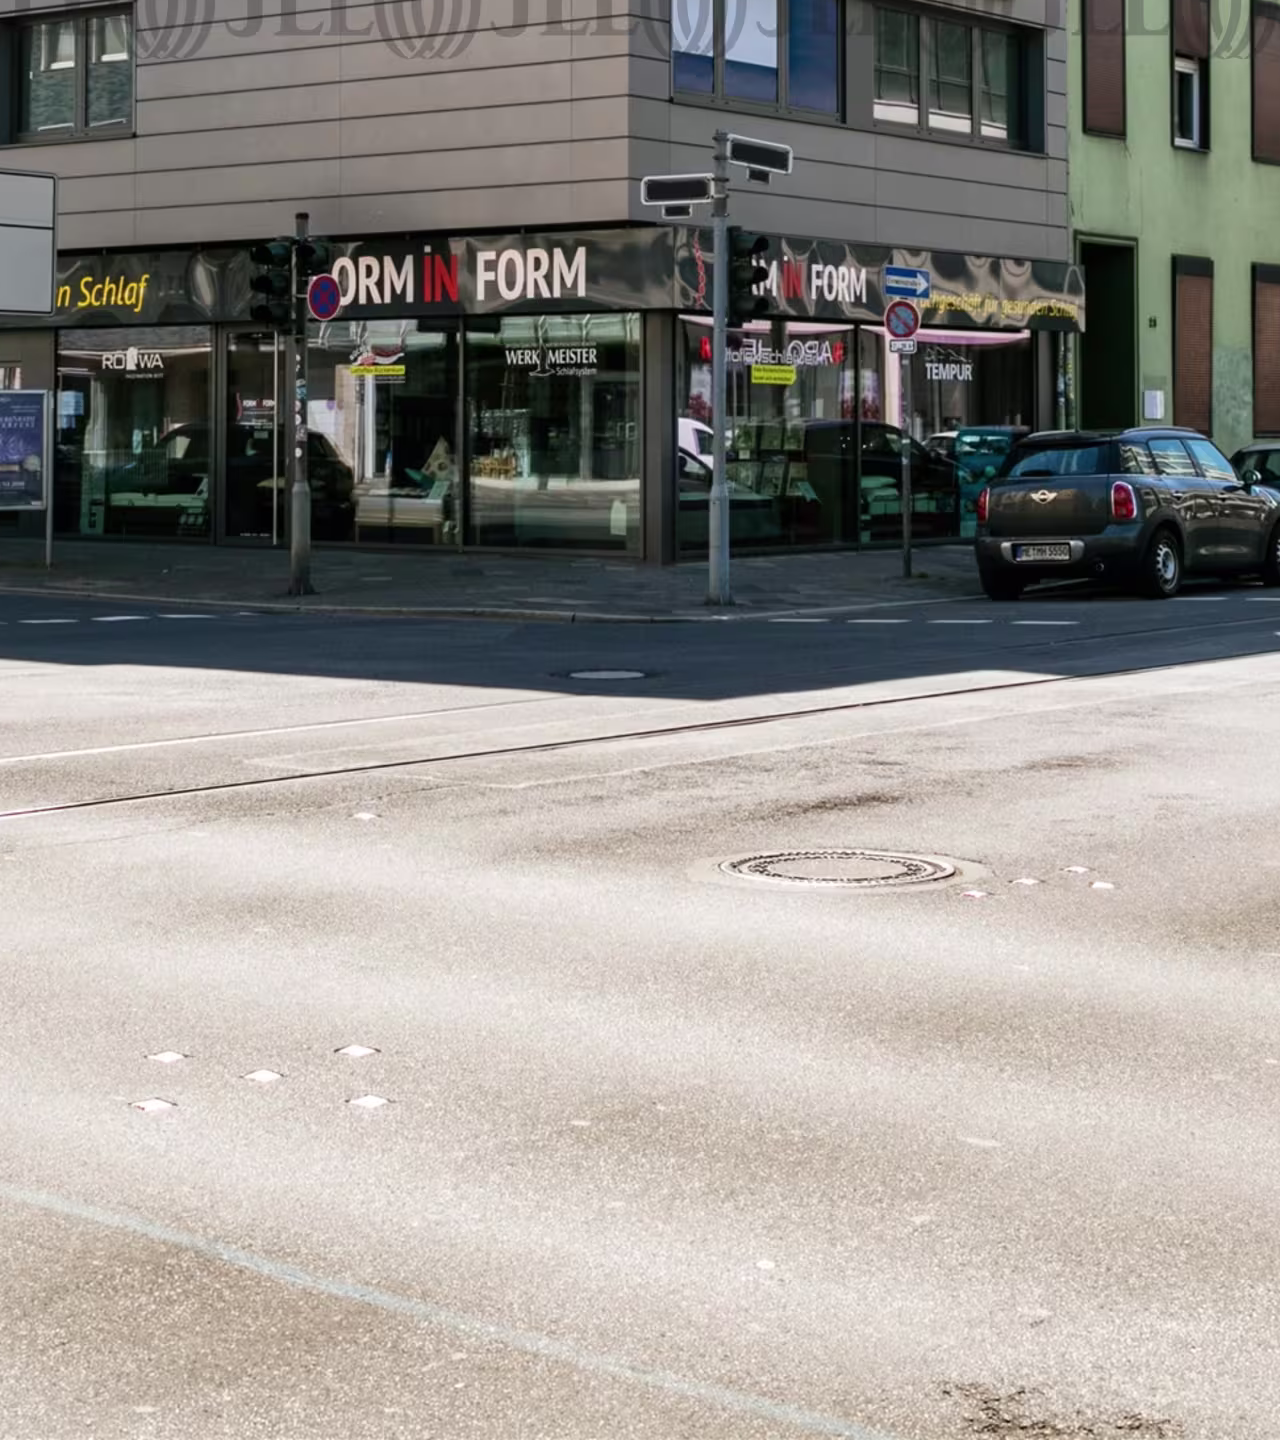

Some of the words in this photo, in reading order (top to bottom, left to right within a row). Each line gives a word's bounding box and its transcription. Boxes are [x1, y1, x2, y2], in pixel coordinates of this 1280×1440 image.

[77, 274, 150, 312] Schlaf
[331, 254, 414, 306] ORM
[476, 246, 586, 301] FORM
[811, 263, 867, 303] FORM
[505, 349, 540, 365] WERK
[547, 348, 598, 364] MEISTER
[925, 363, 973, 381] TEMPUR
